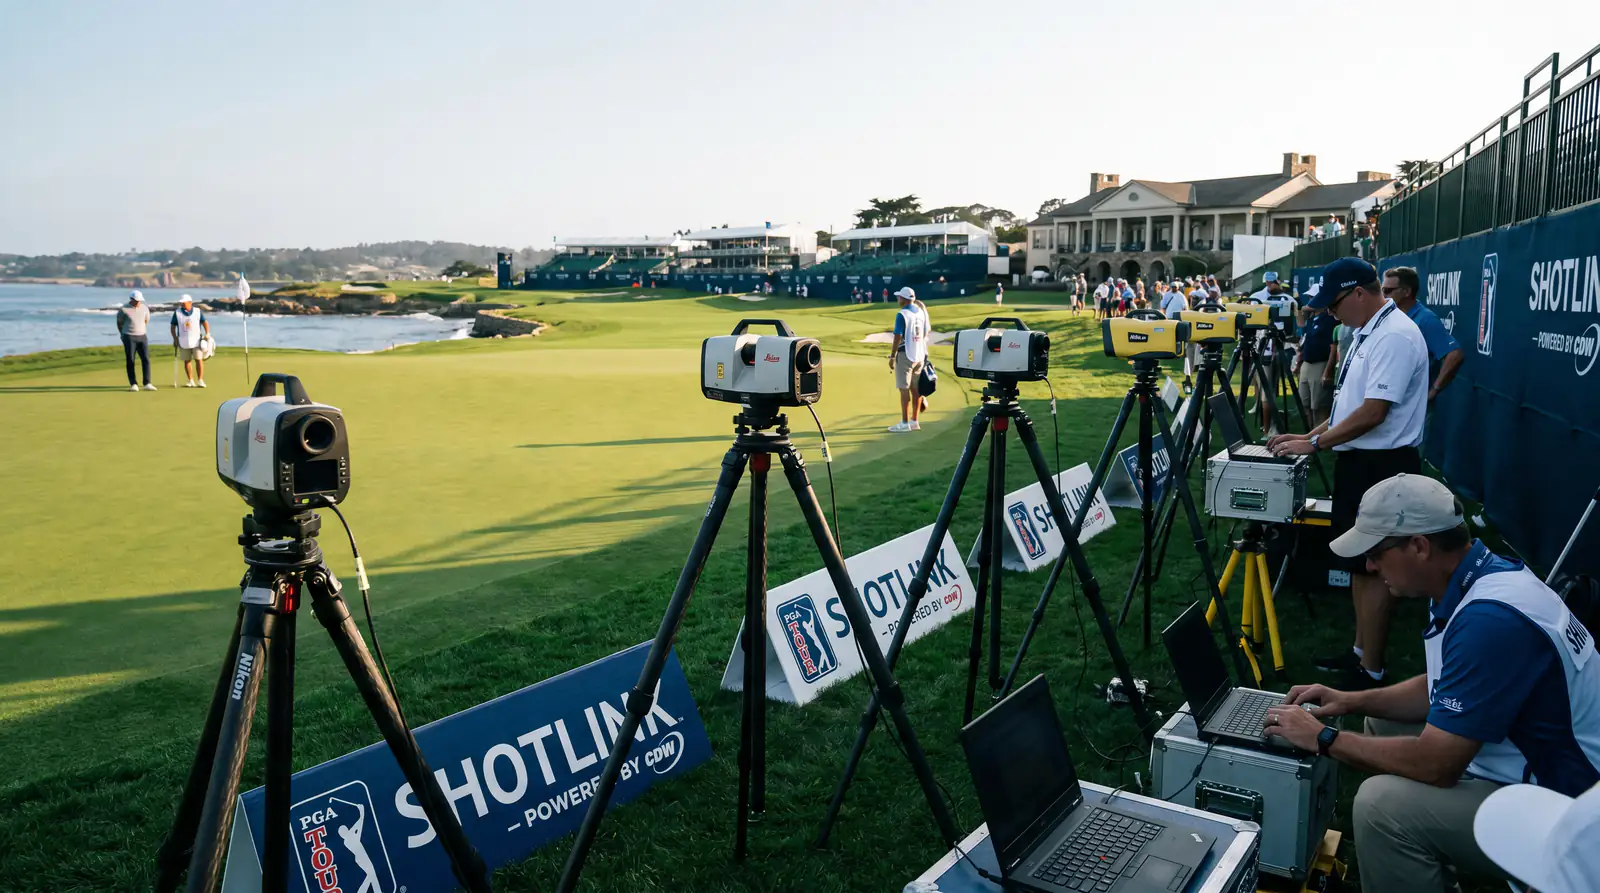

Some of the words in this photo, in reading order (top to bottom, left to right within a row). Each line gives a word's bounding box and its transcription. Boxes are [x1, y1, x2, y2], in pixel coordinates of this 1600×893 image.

[1426, 270, 1462, 306] SHOTLINK
[1564, 335, 1575, 353] BY
[784, 610, 802, 624] PGA
[931, 597, 943, 613] BY
[788, 622, 817, 676] TOUR
[231, 652, 254, 700] Nikon
[620, 756, 640, 781] BY
[644, 739, 676, 768] CDW
[299, 807, 338, 830] PGA
[303, 825, 344, 893] TOU
